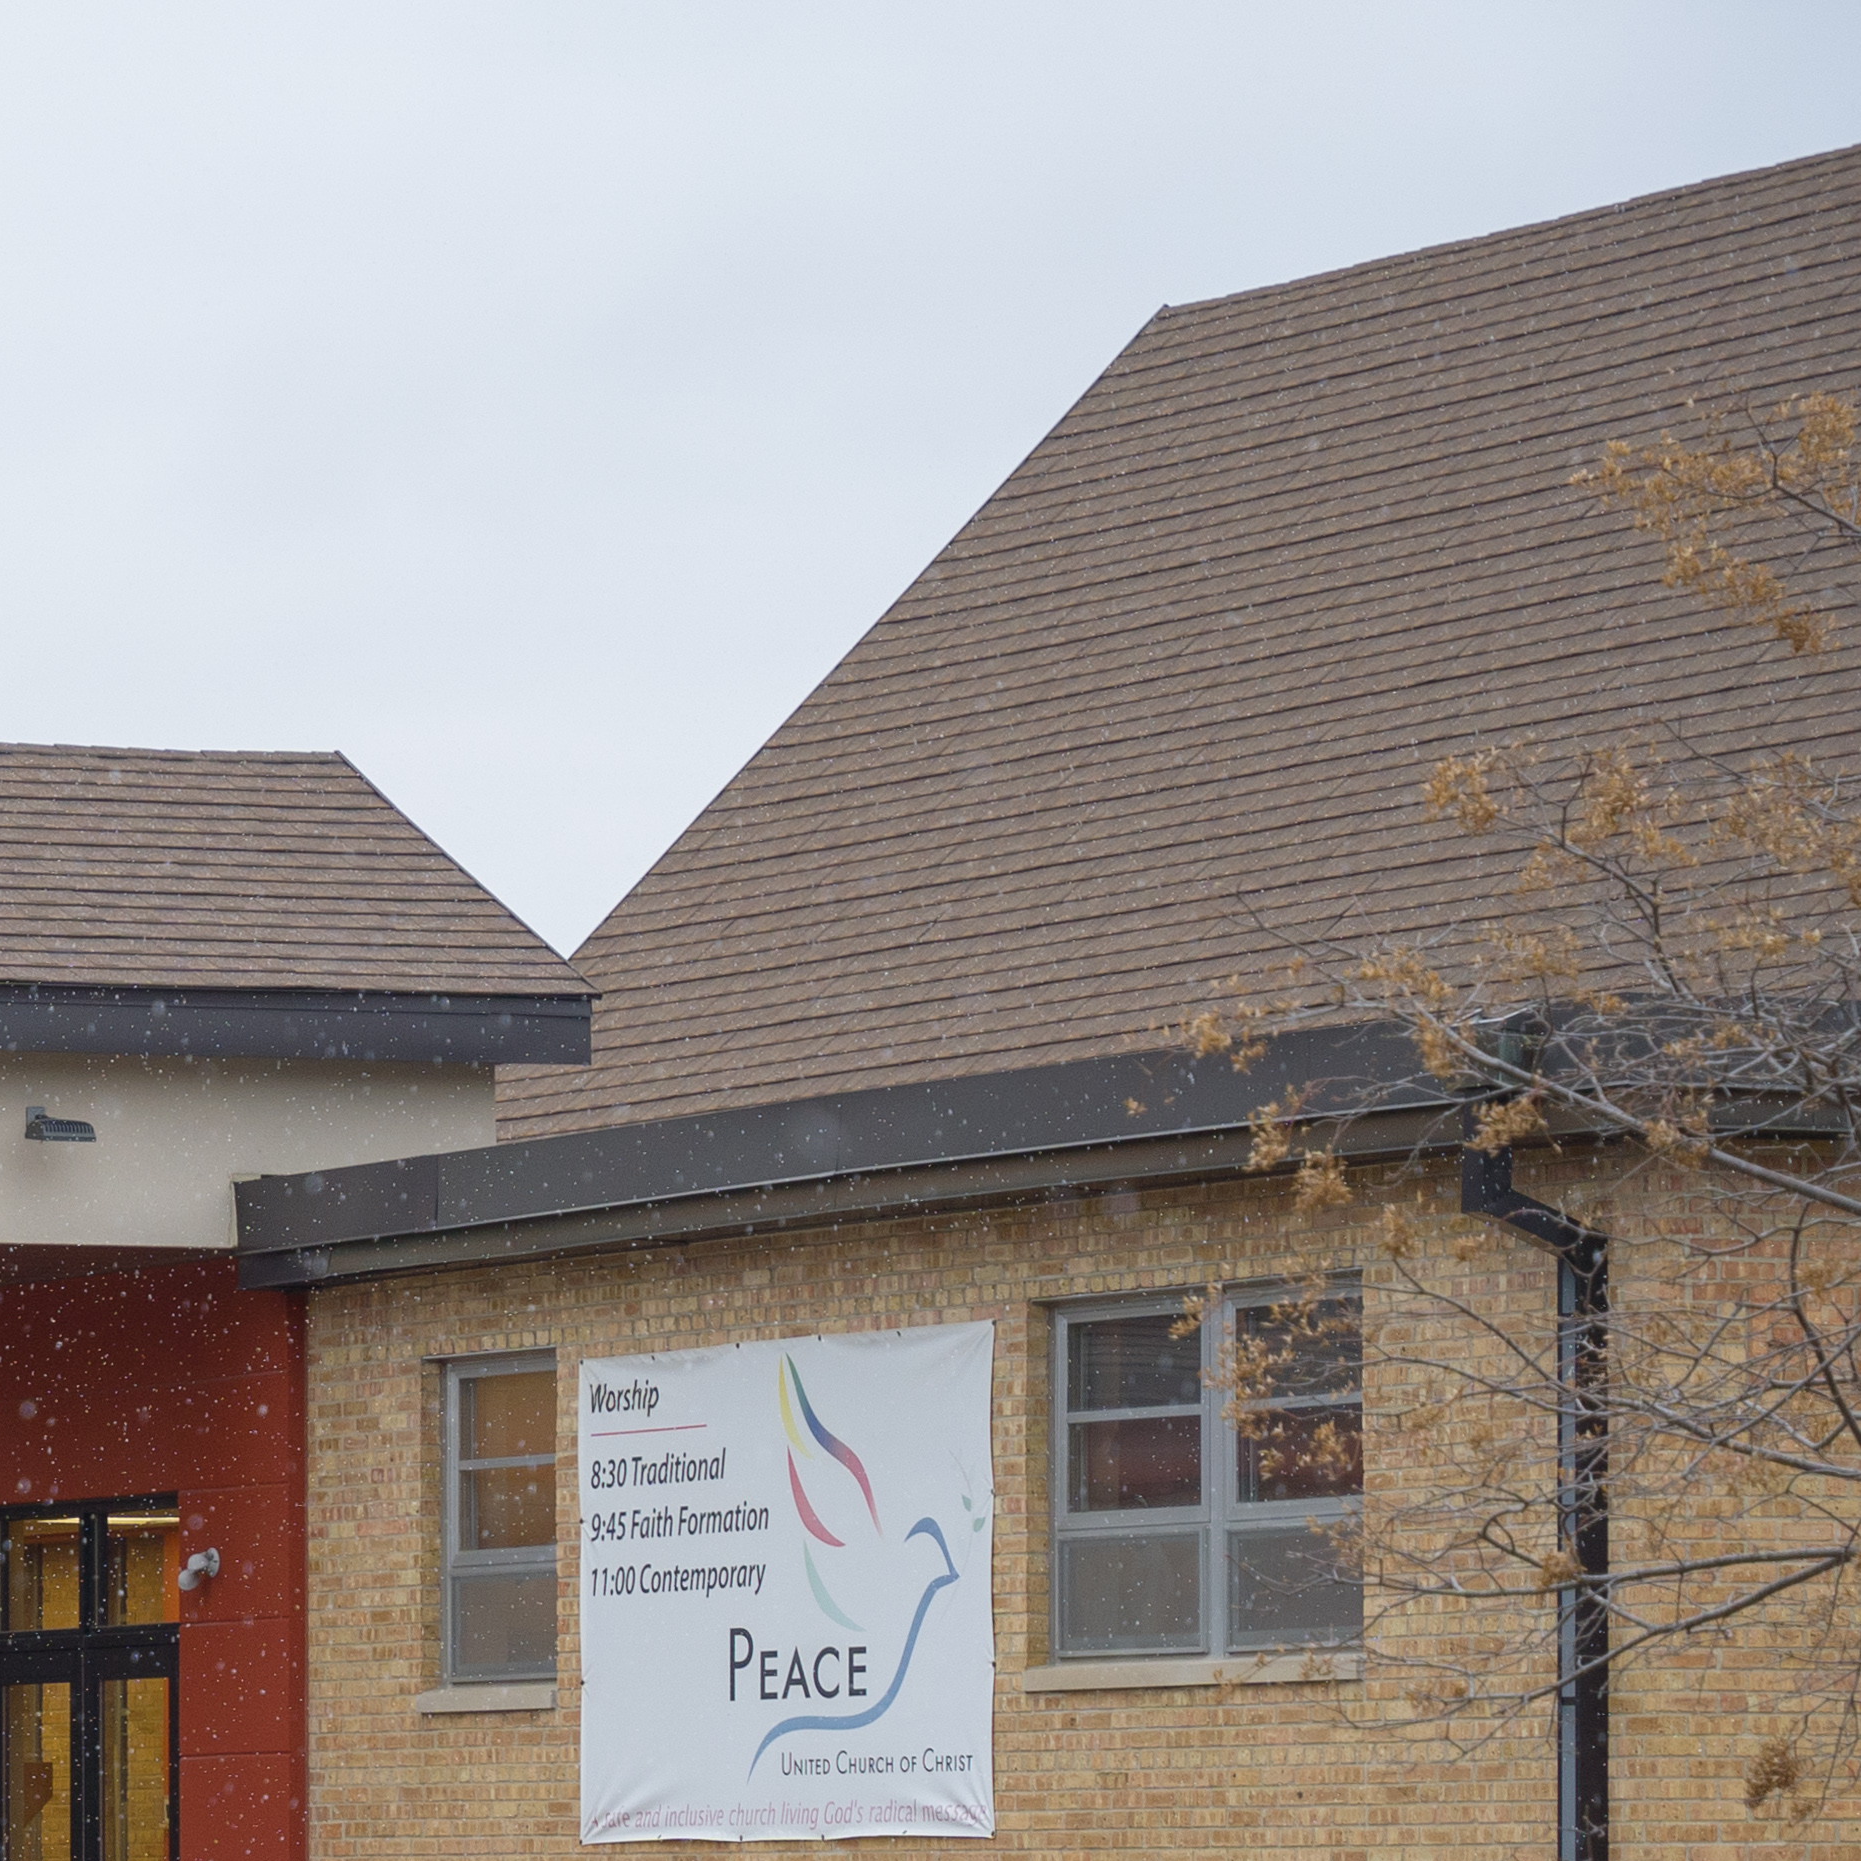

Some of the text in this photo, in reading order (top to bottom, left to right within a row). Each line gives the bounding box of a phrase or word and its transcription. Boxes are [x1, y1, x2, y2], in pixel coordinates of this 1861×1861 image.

[590, 1379, 660, 1417] Worship
[591, 1447, 726, 1489] 8:30 Traditional
[591, 1501, 769, 1542] 9:45 Faith Formation
[591, 1564, 766, 1598] 11:00 Contemporary
[729, 1627, 868, 1701] PEACE
[781, 1752, 830, 1775] UNITED
[836, 1750, 894, 1774] CHURCH
[923, 1748, 973, 1772] CHRIST
[634, 1804, 661, 1828] and
[665, 1803, 724, 1828] inclusive
[728, 1801, 775, 1827] church
[780, 1800, 819, 1830] living
[824, 1800, 863, 1825] God's
[869, 1798, 917, 1824] radical
[922, 1803, 987, 1828] message
